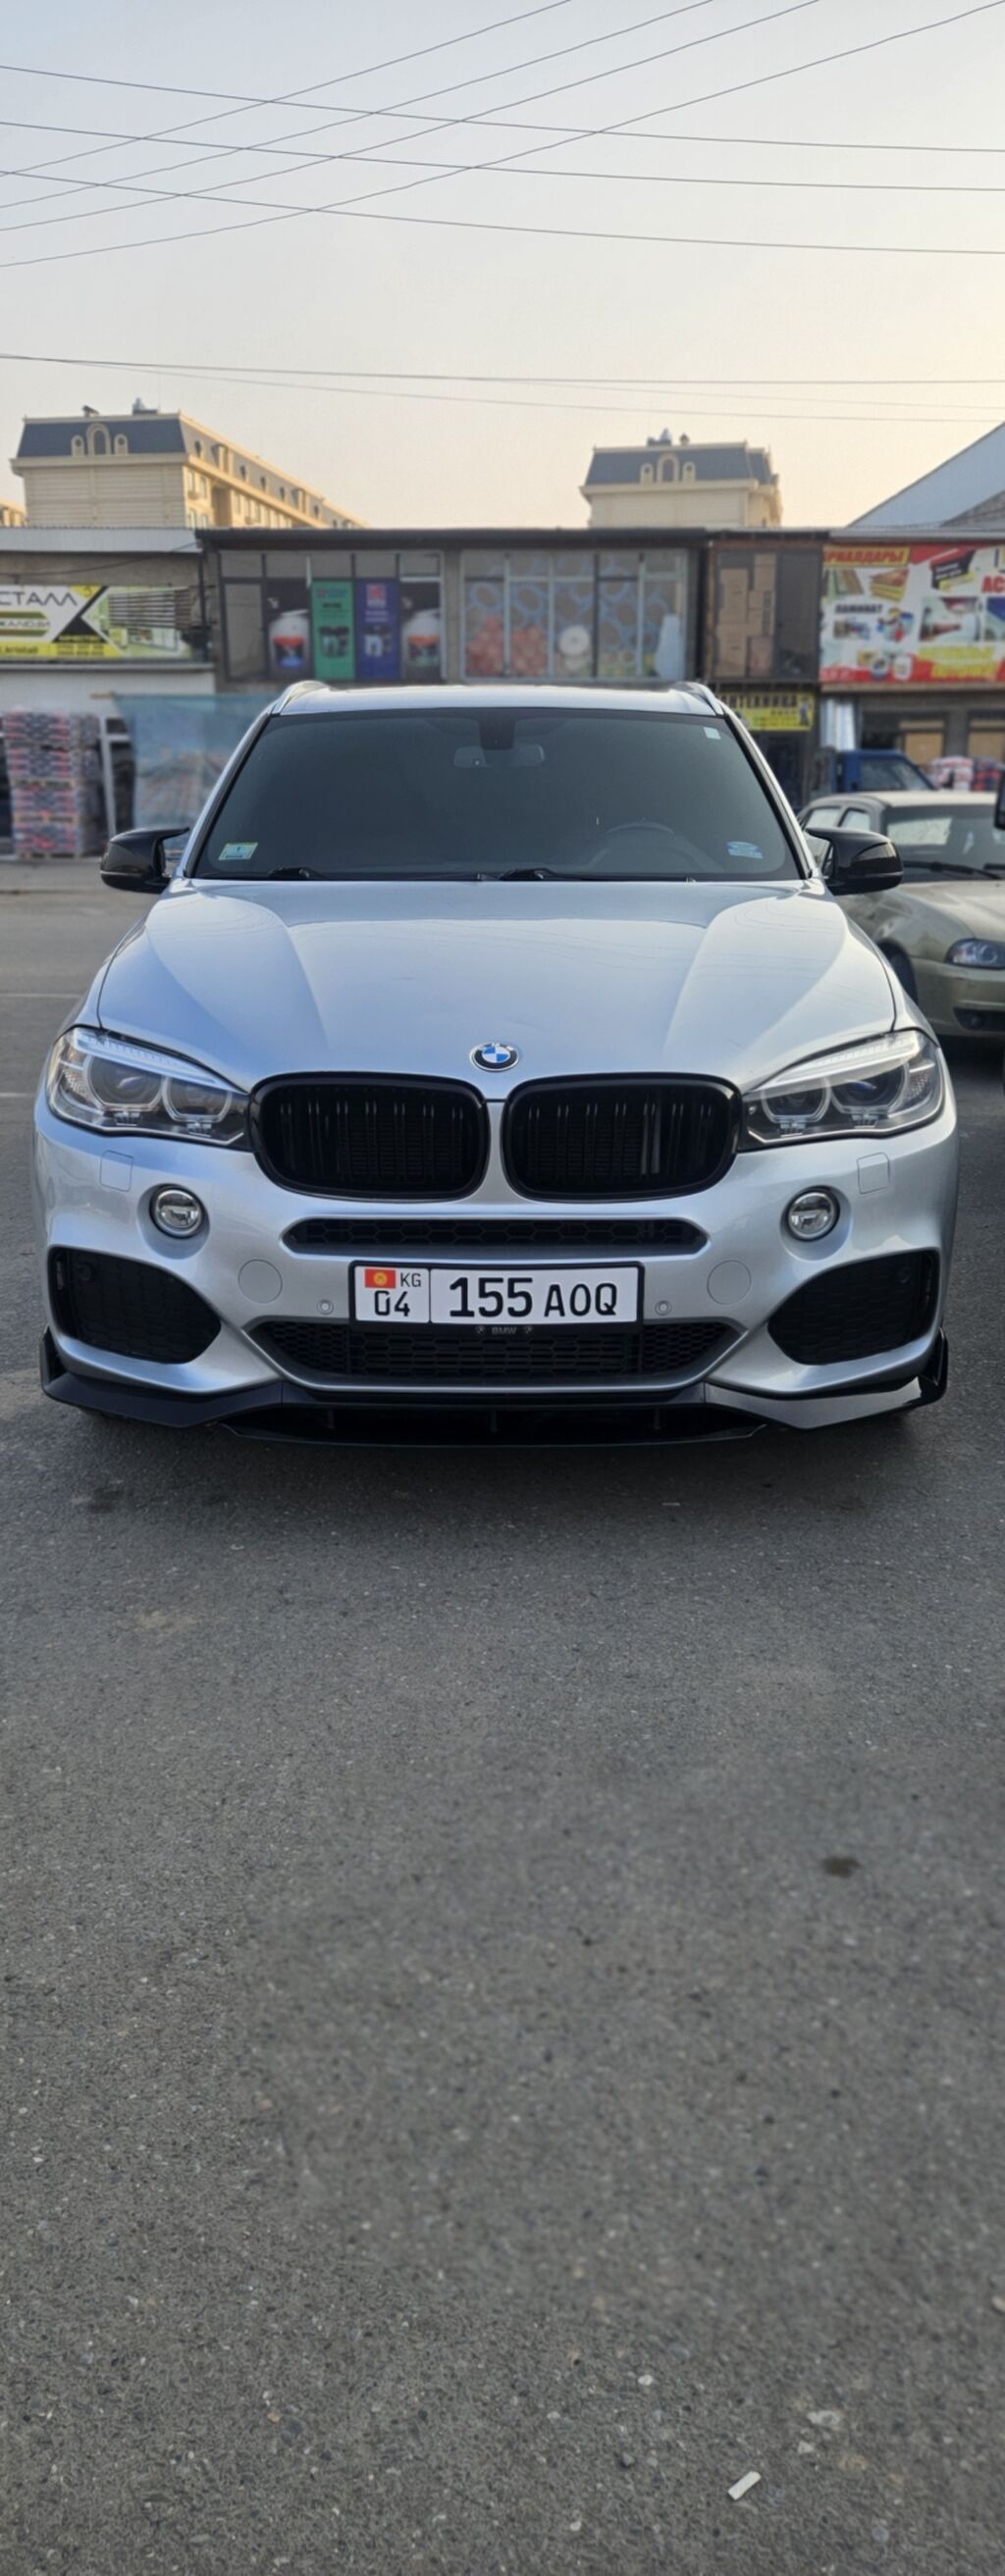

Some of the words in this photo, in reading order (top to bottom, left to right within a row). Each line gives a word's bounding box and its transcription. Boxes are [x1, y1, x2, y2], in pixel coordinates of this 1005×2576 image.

[399, 1272, 422, 1288] KG
[374, 1290, 410, 1316] 04
[450, 1277, 534, 1317] 155
[544, 1283, 617, 1317] AOQ
[492, 1326, 517, 1335] BMW
